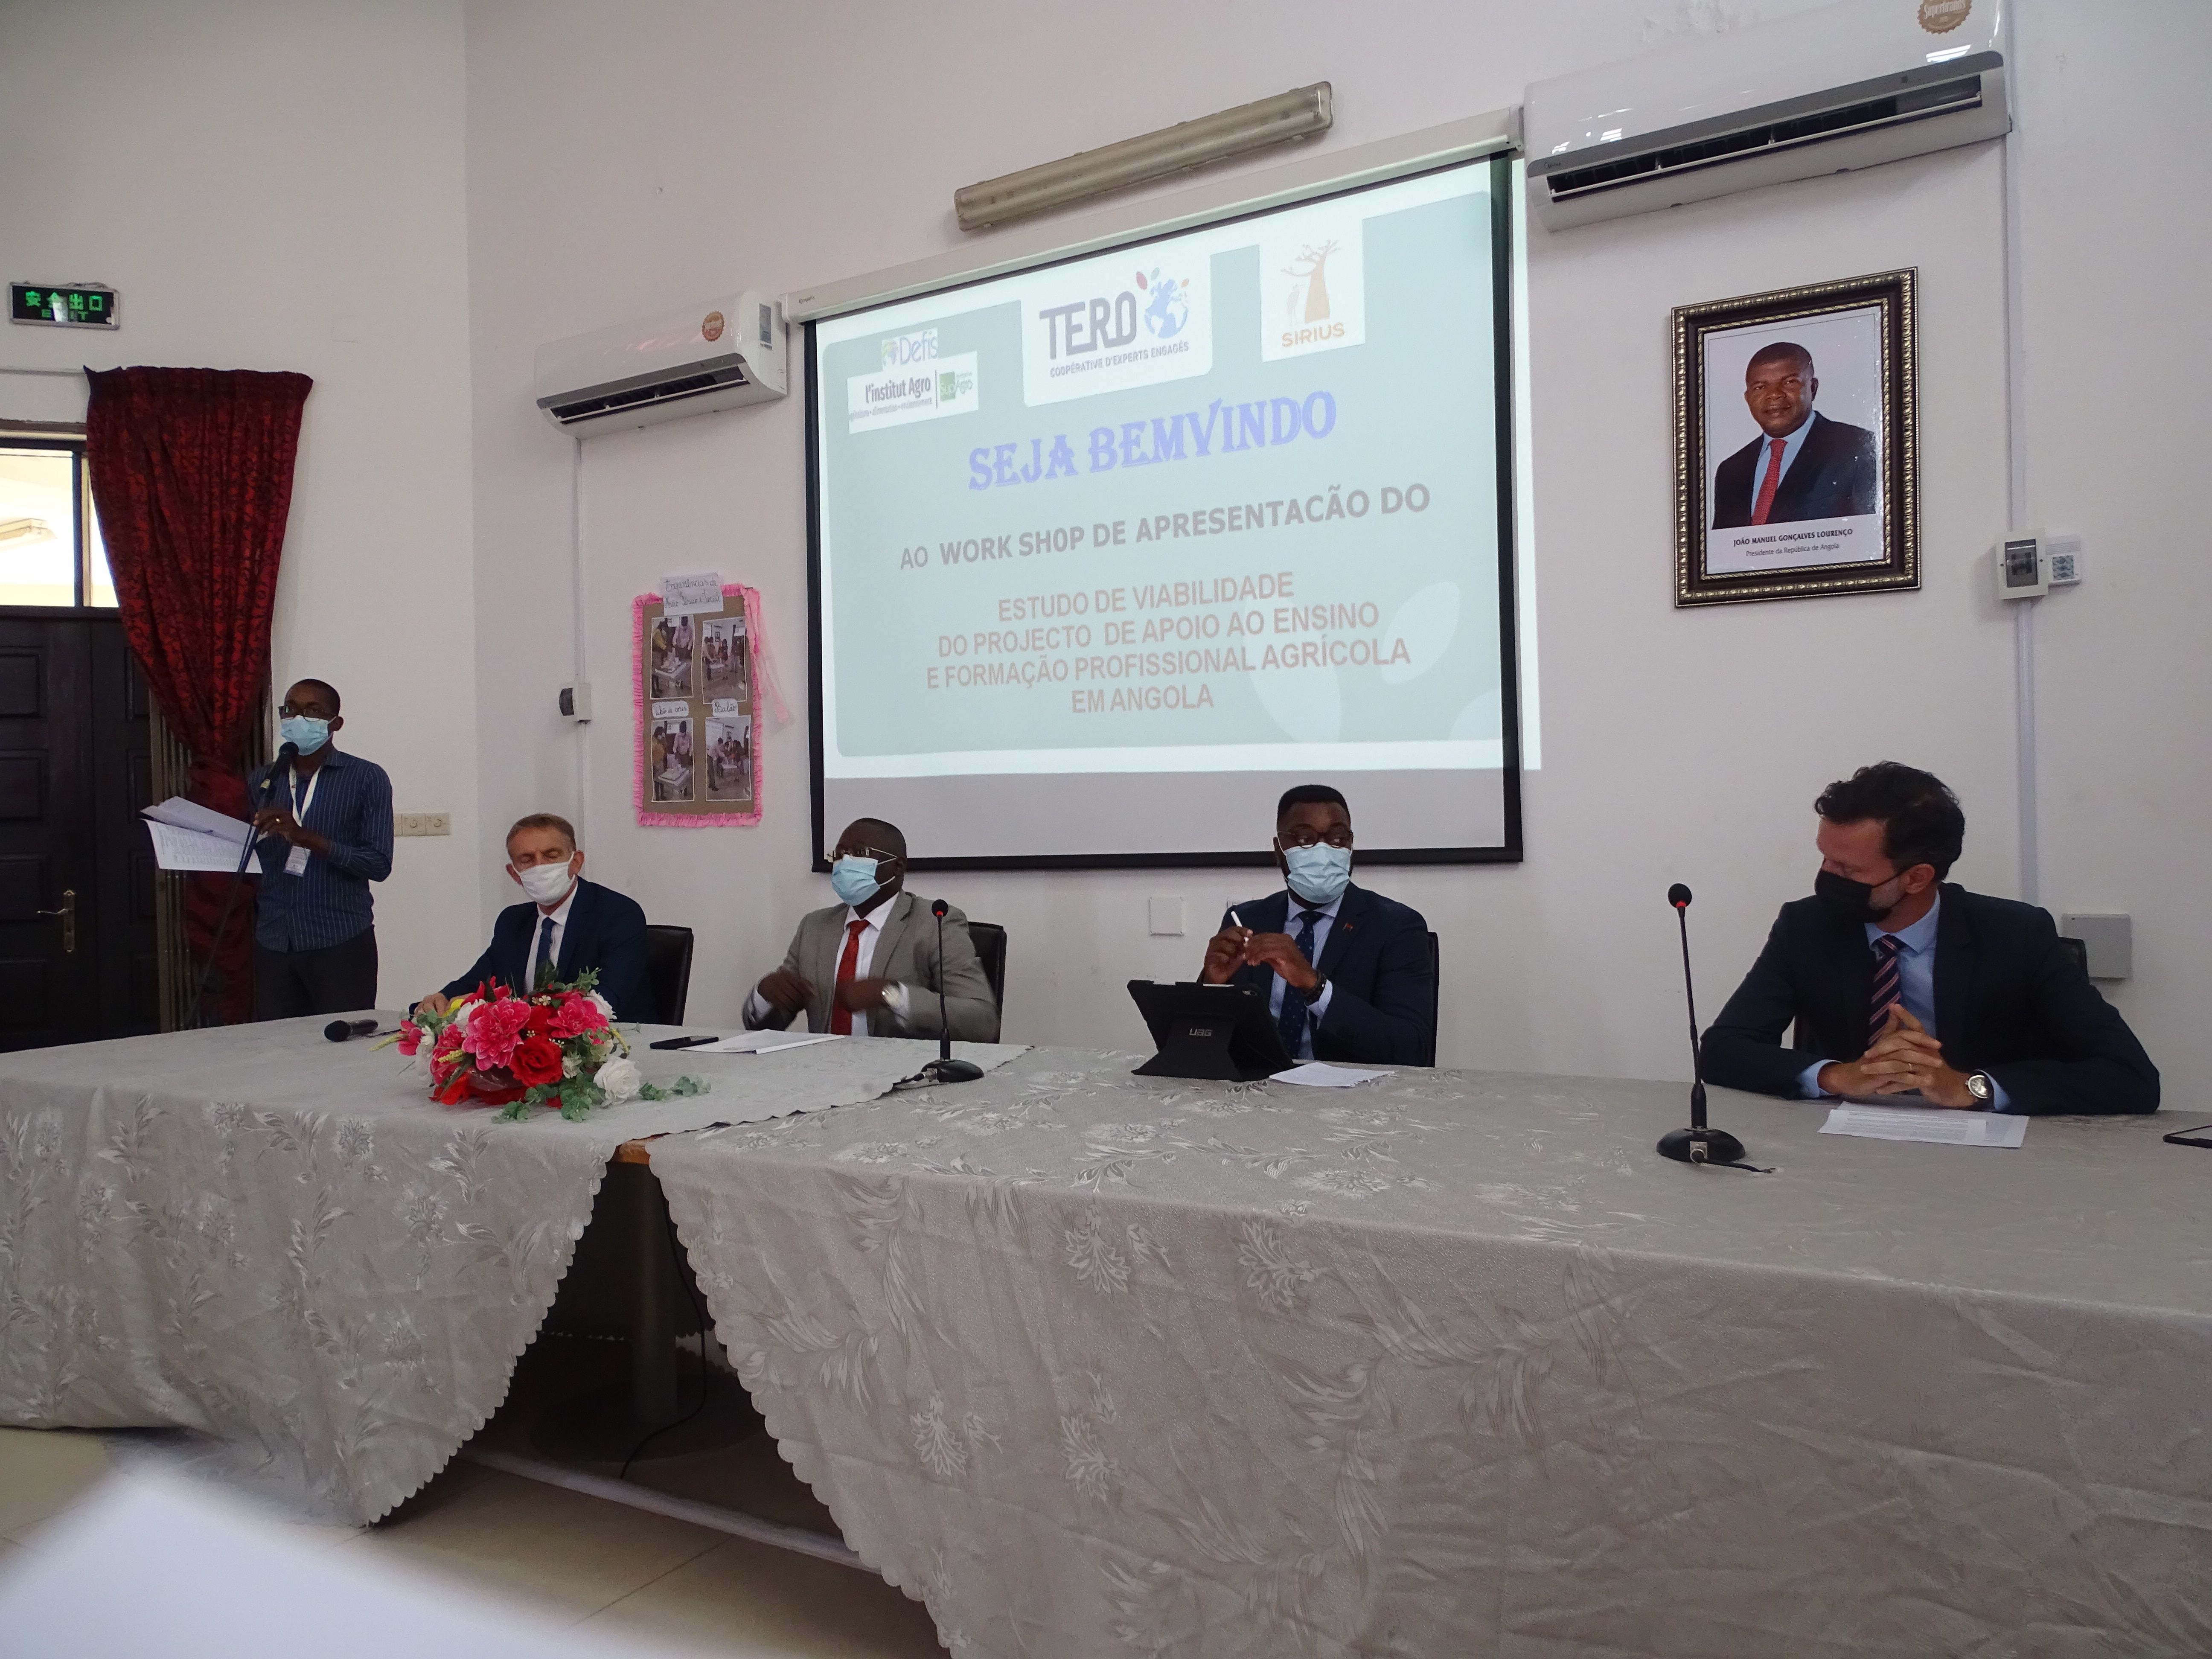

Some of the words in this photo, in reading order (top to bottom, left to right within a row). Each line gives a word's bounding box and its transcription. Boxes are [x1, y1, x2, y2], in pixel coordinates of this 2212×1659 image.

[41, 309, 88, 320] EIT
[1039, 291, 1136, 360] TERO
[1281, 322, 1345, 347] SIRIUS
[1050, 357, 1104, 377] COOPÉRATIVE
[1106, 349, 1149, 369] D'EXPERTS
[1150, 340, 1189, 359] ENGAGÉS
[909, 377, 931, 398] Agro
[968, 434, 1079, 490] SEJA
[1089, 390, 1336, 472] BEMVINDO
[899, 546, 928, 570] AO
[939, 535, 1013, 565] WORK
[1018, 526, 1084, 556] SHOP
[1093, 521, 1125, 548] DE
[1135, 484, 1369, 543] APRESENTACÃO
[1381, 483, 1430, 514] DO
[1734, 537, 1749, 547] JOÃO
[1779, 532, 1815, 541] GONÇALVES
[1817, 529, 1853, 538] LOURENÇO
[1746, 548, 1774, 556] Presidente
[1784, 545, 1810, 554] República
[1820, 542, 1839, 551] Angola
[998, 591, 1088, 622] ESTUDO
[1095, 588, 1126, 613] DE
[1132, 571, 1293, 610] VIABILIDADE
[939, 634, 967, 657] DO
[974, 626, 1091, 655] PROJECTO
[1104, 620, 1134, 646] DE
[1142, 614, 1219, 643] APOIO
[1227, 609, 1264, 637] AO
[1274, 602, 1379, 634] ENSINO
[927, 667, 938, 689] E
[945, 655, 1068, 689] FORMAÇÃO
[1075, 646, 1255, 681] PROFISSIONAL
[1262, 634, 1411, 670] AGRÍCOLA
[1072, 690, 1104, 713] EM
[1110, 684, 1213, 713] ANGOLA
